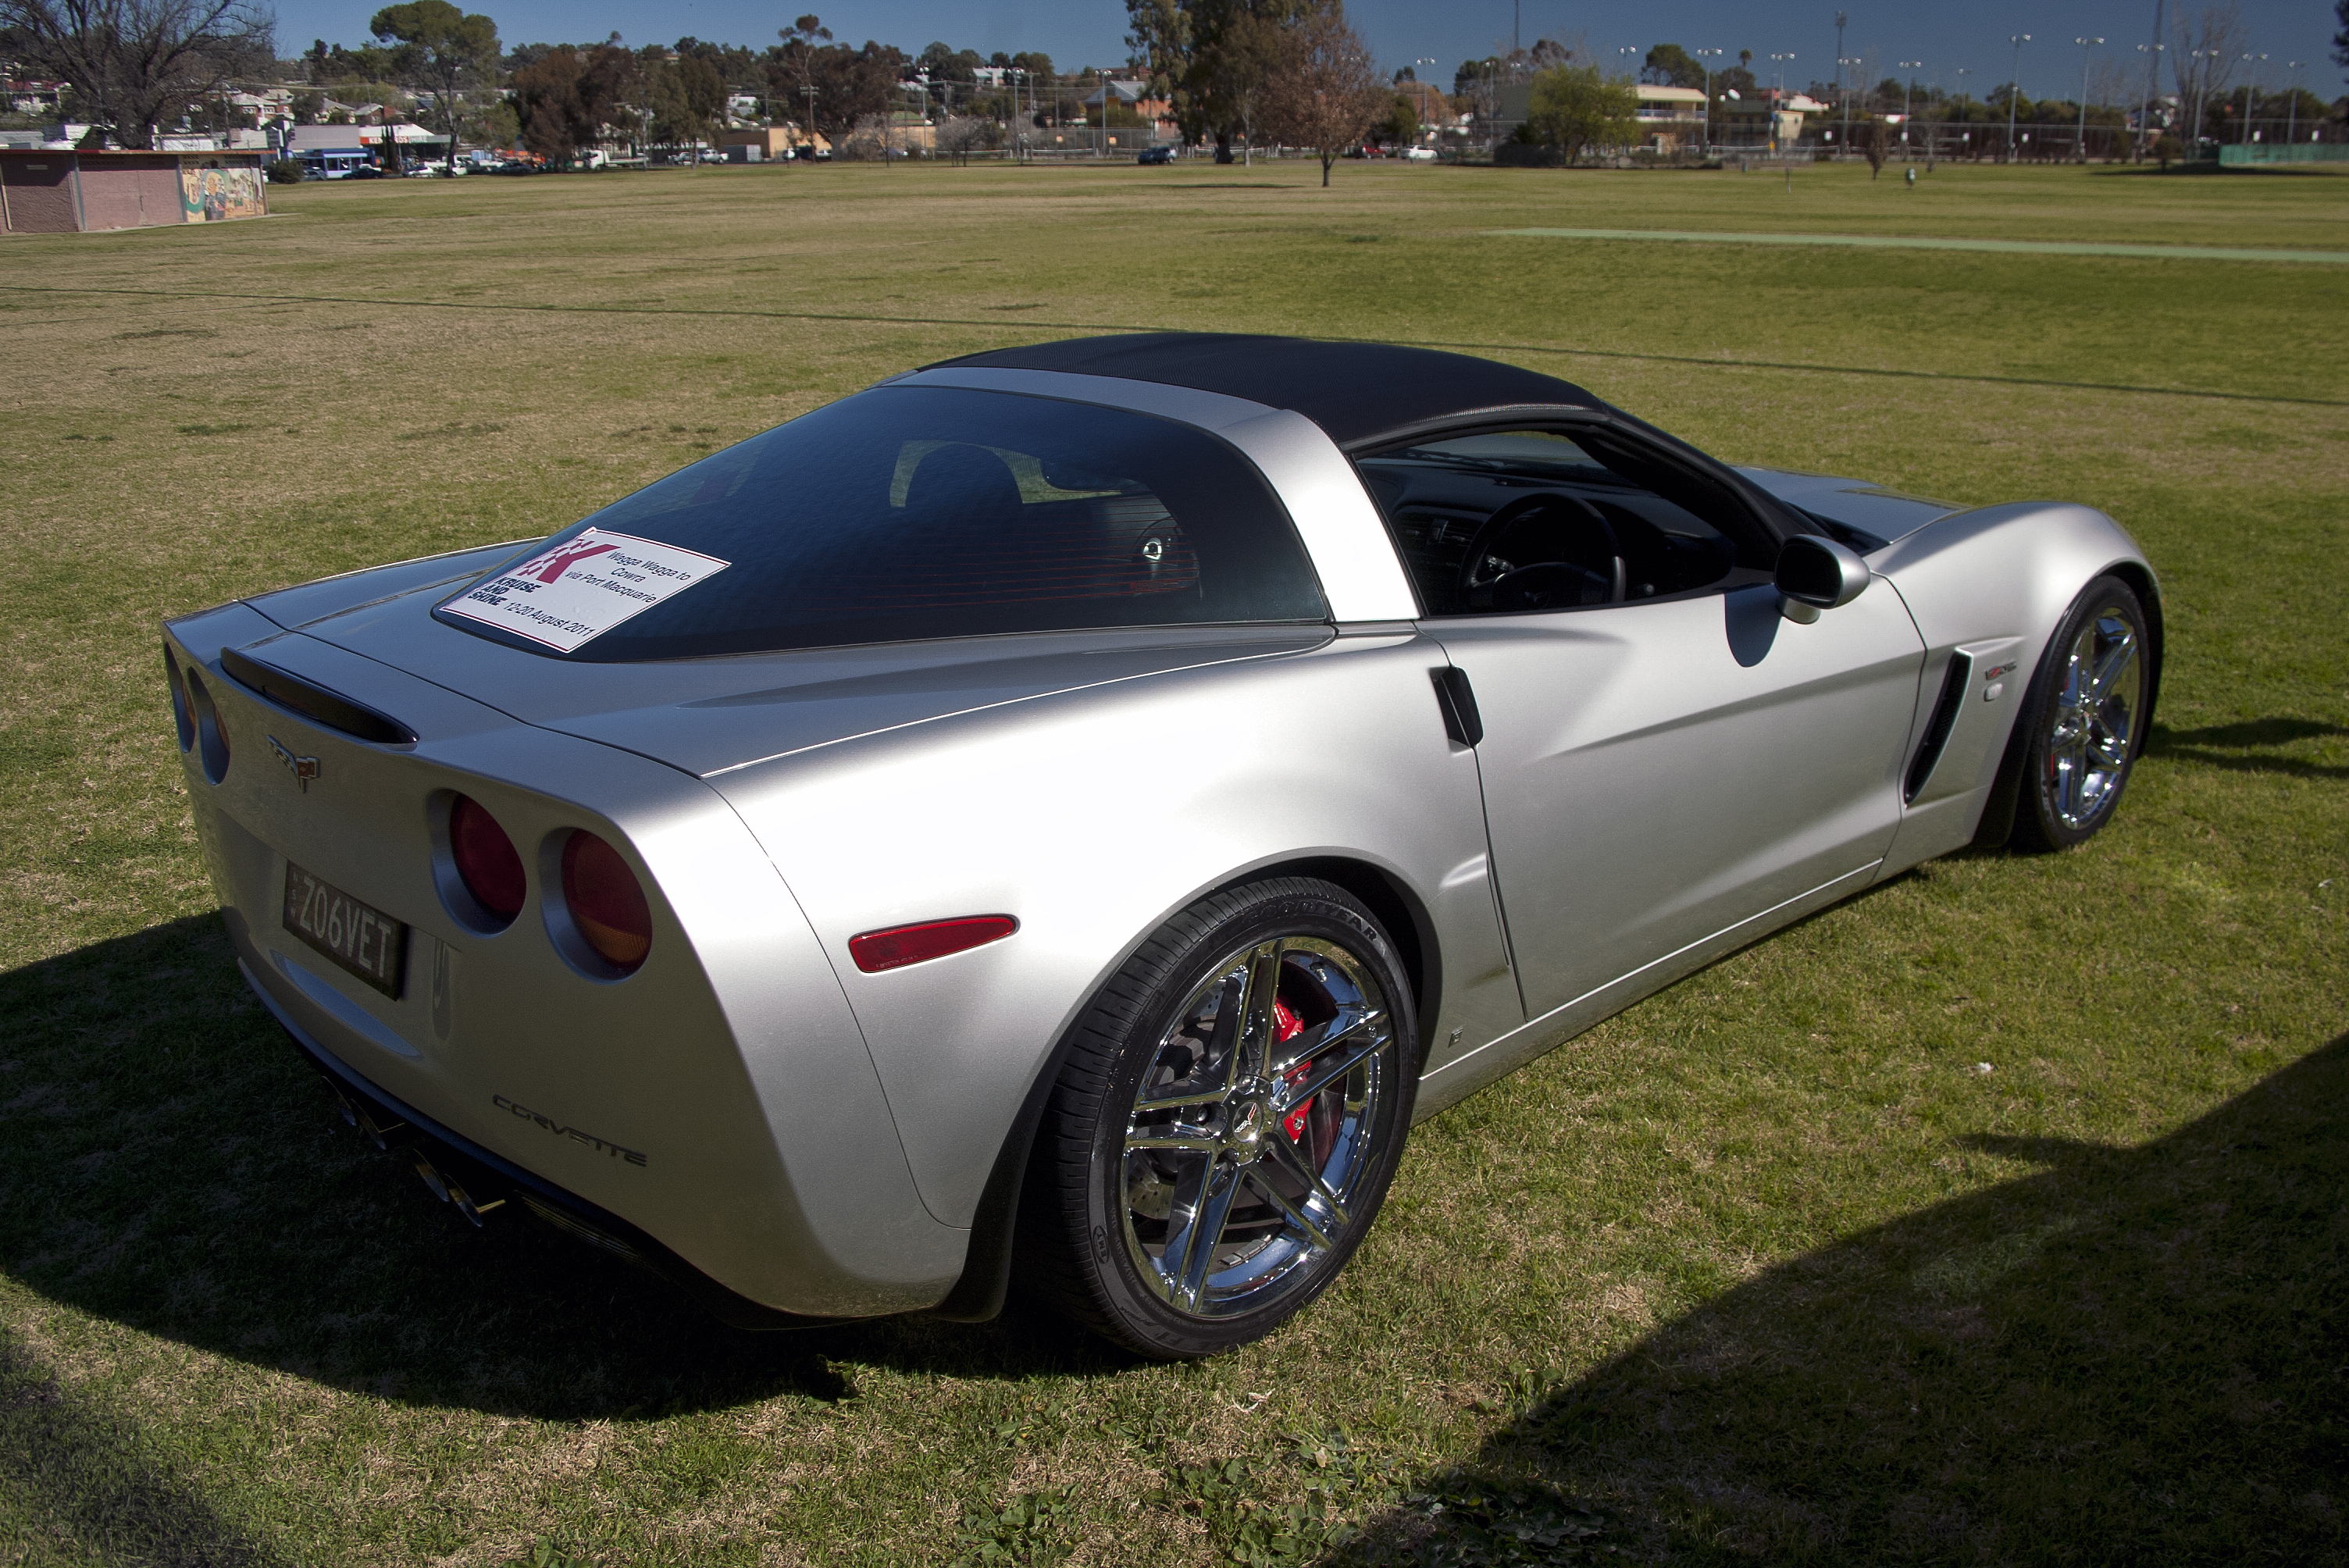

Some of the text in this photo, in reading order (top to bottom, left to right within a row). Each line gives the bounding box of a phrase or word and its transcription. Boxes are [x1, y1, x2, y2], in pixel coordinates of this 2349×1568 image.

[606, 551, 692, 581] Wagga Wagga to
[610, 568, 647, 583] Cowra
[482, 584, 511, 595] AND
[494, 576, 543, 593] KRUISE
[565, 571, 658, 604] via Port Macquarie
[468, 591, 509, 607] SHINE
[504, 601, 597, 638] 12-20 August 2011
[493, 1094, 647, 1167] CORVETTE
